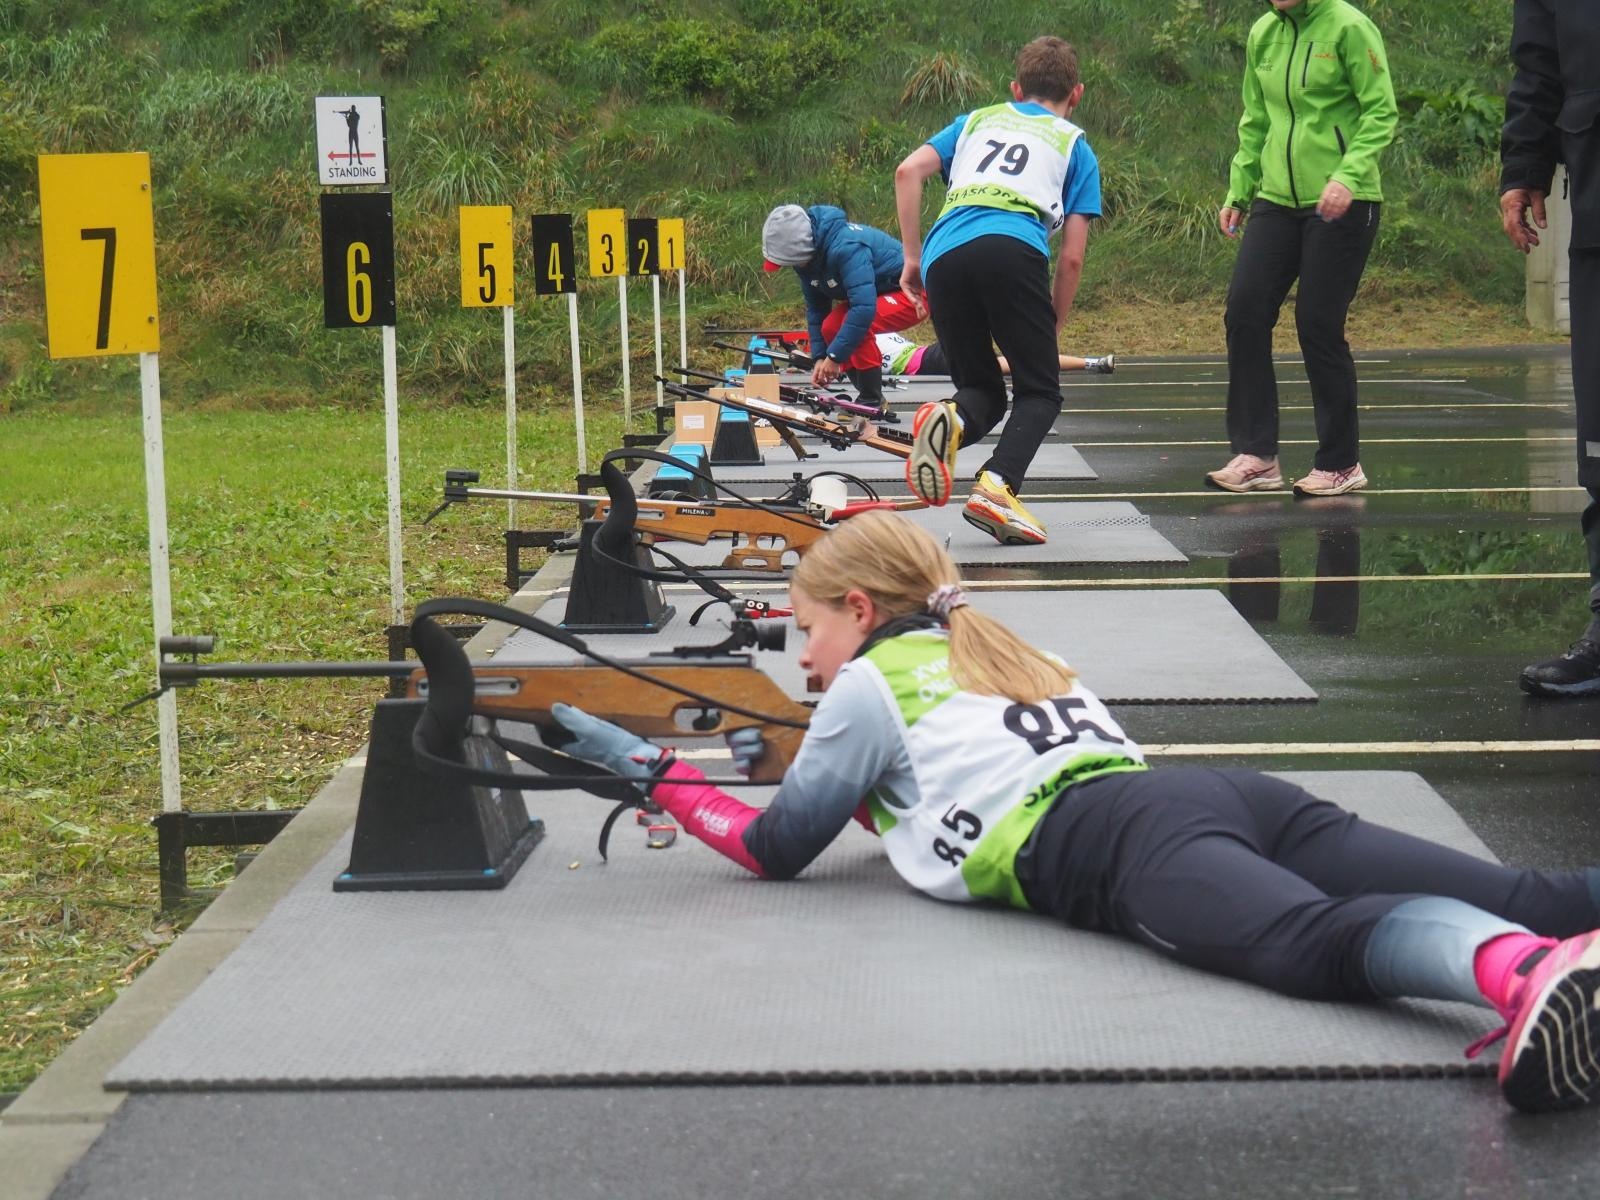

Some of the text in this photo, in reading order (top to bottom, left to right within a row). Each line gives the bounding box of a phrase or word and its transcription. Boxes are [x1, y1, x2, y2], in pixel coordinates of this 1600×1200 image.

[328, 166, 377, 178] STANDING
[976, 139, 1030, 176] 79
[478, 242, 497, 303] 5
[547, 242, 564, 292] 4
[600, 233, 614, 274] 3
[637, 238, 650, 275] 2
[667, 237, 675, 268] 1
[80, 227, 117, 350] 7
[346, 241, 373, 324] 6
[933, 802, 983, 868] 85
